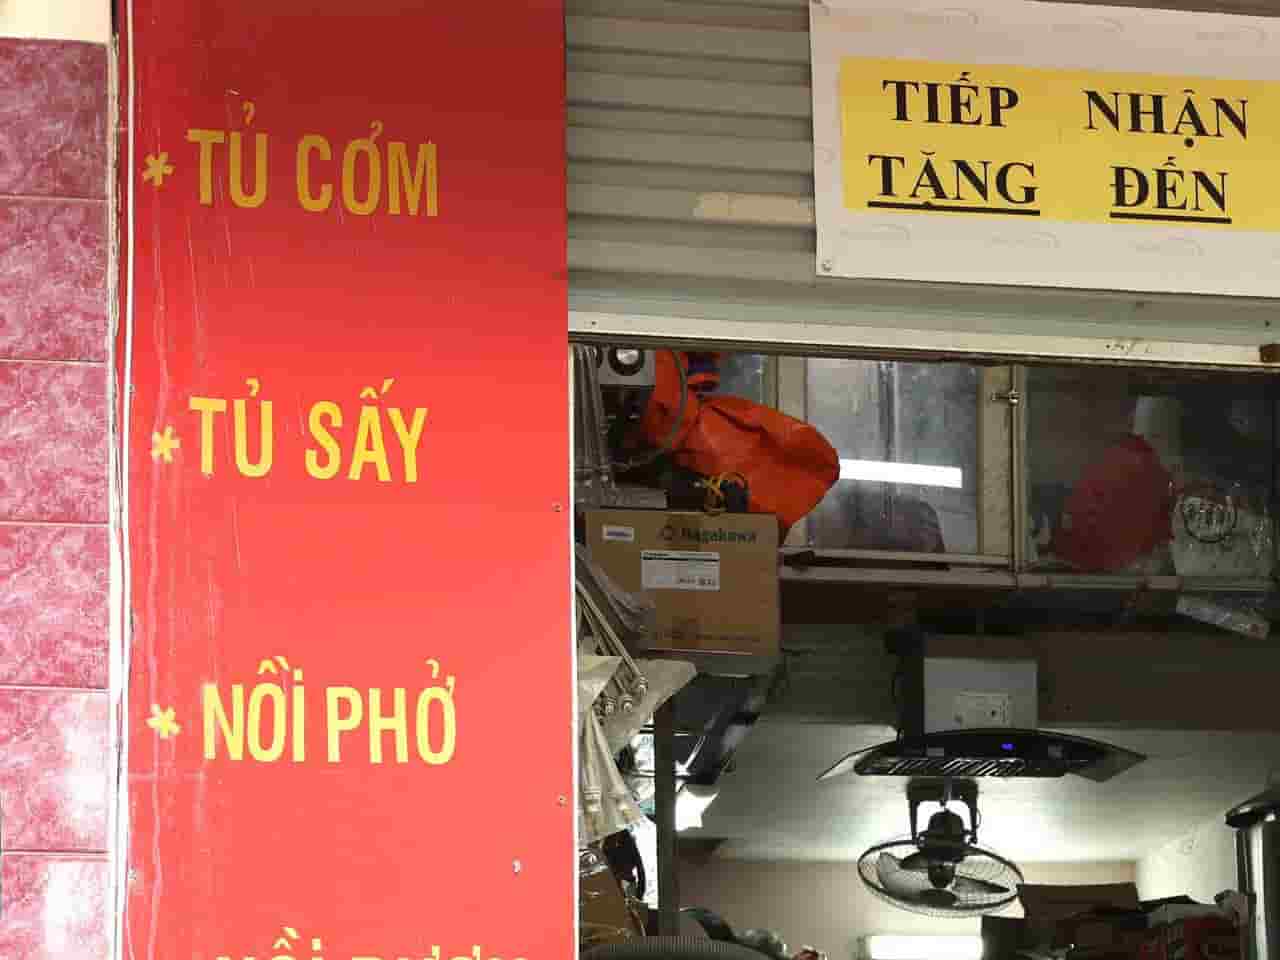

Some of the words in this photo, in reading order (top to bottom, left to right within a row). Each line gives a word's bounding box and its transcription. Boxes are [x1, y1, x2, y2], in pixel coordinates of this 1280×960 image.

[187, 101, 268, 208] TỦ
[882, 71, 1019, 128] TIẾP
[1082, 89, 1249, 148] NHẬN
[1110, 156, 1230, 213] ĐẾN
[189, 378, 273, 478] TỦ
[304, 378, 428, 483] SẤY
[203, 656, 305, 762] NỒI
[326, 659, 456, 764] PHỞ
